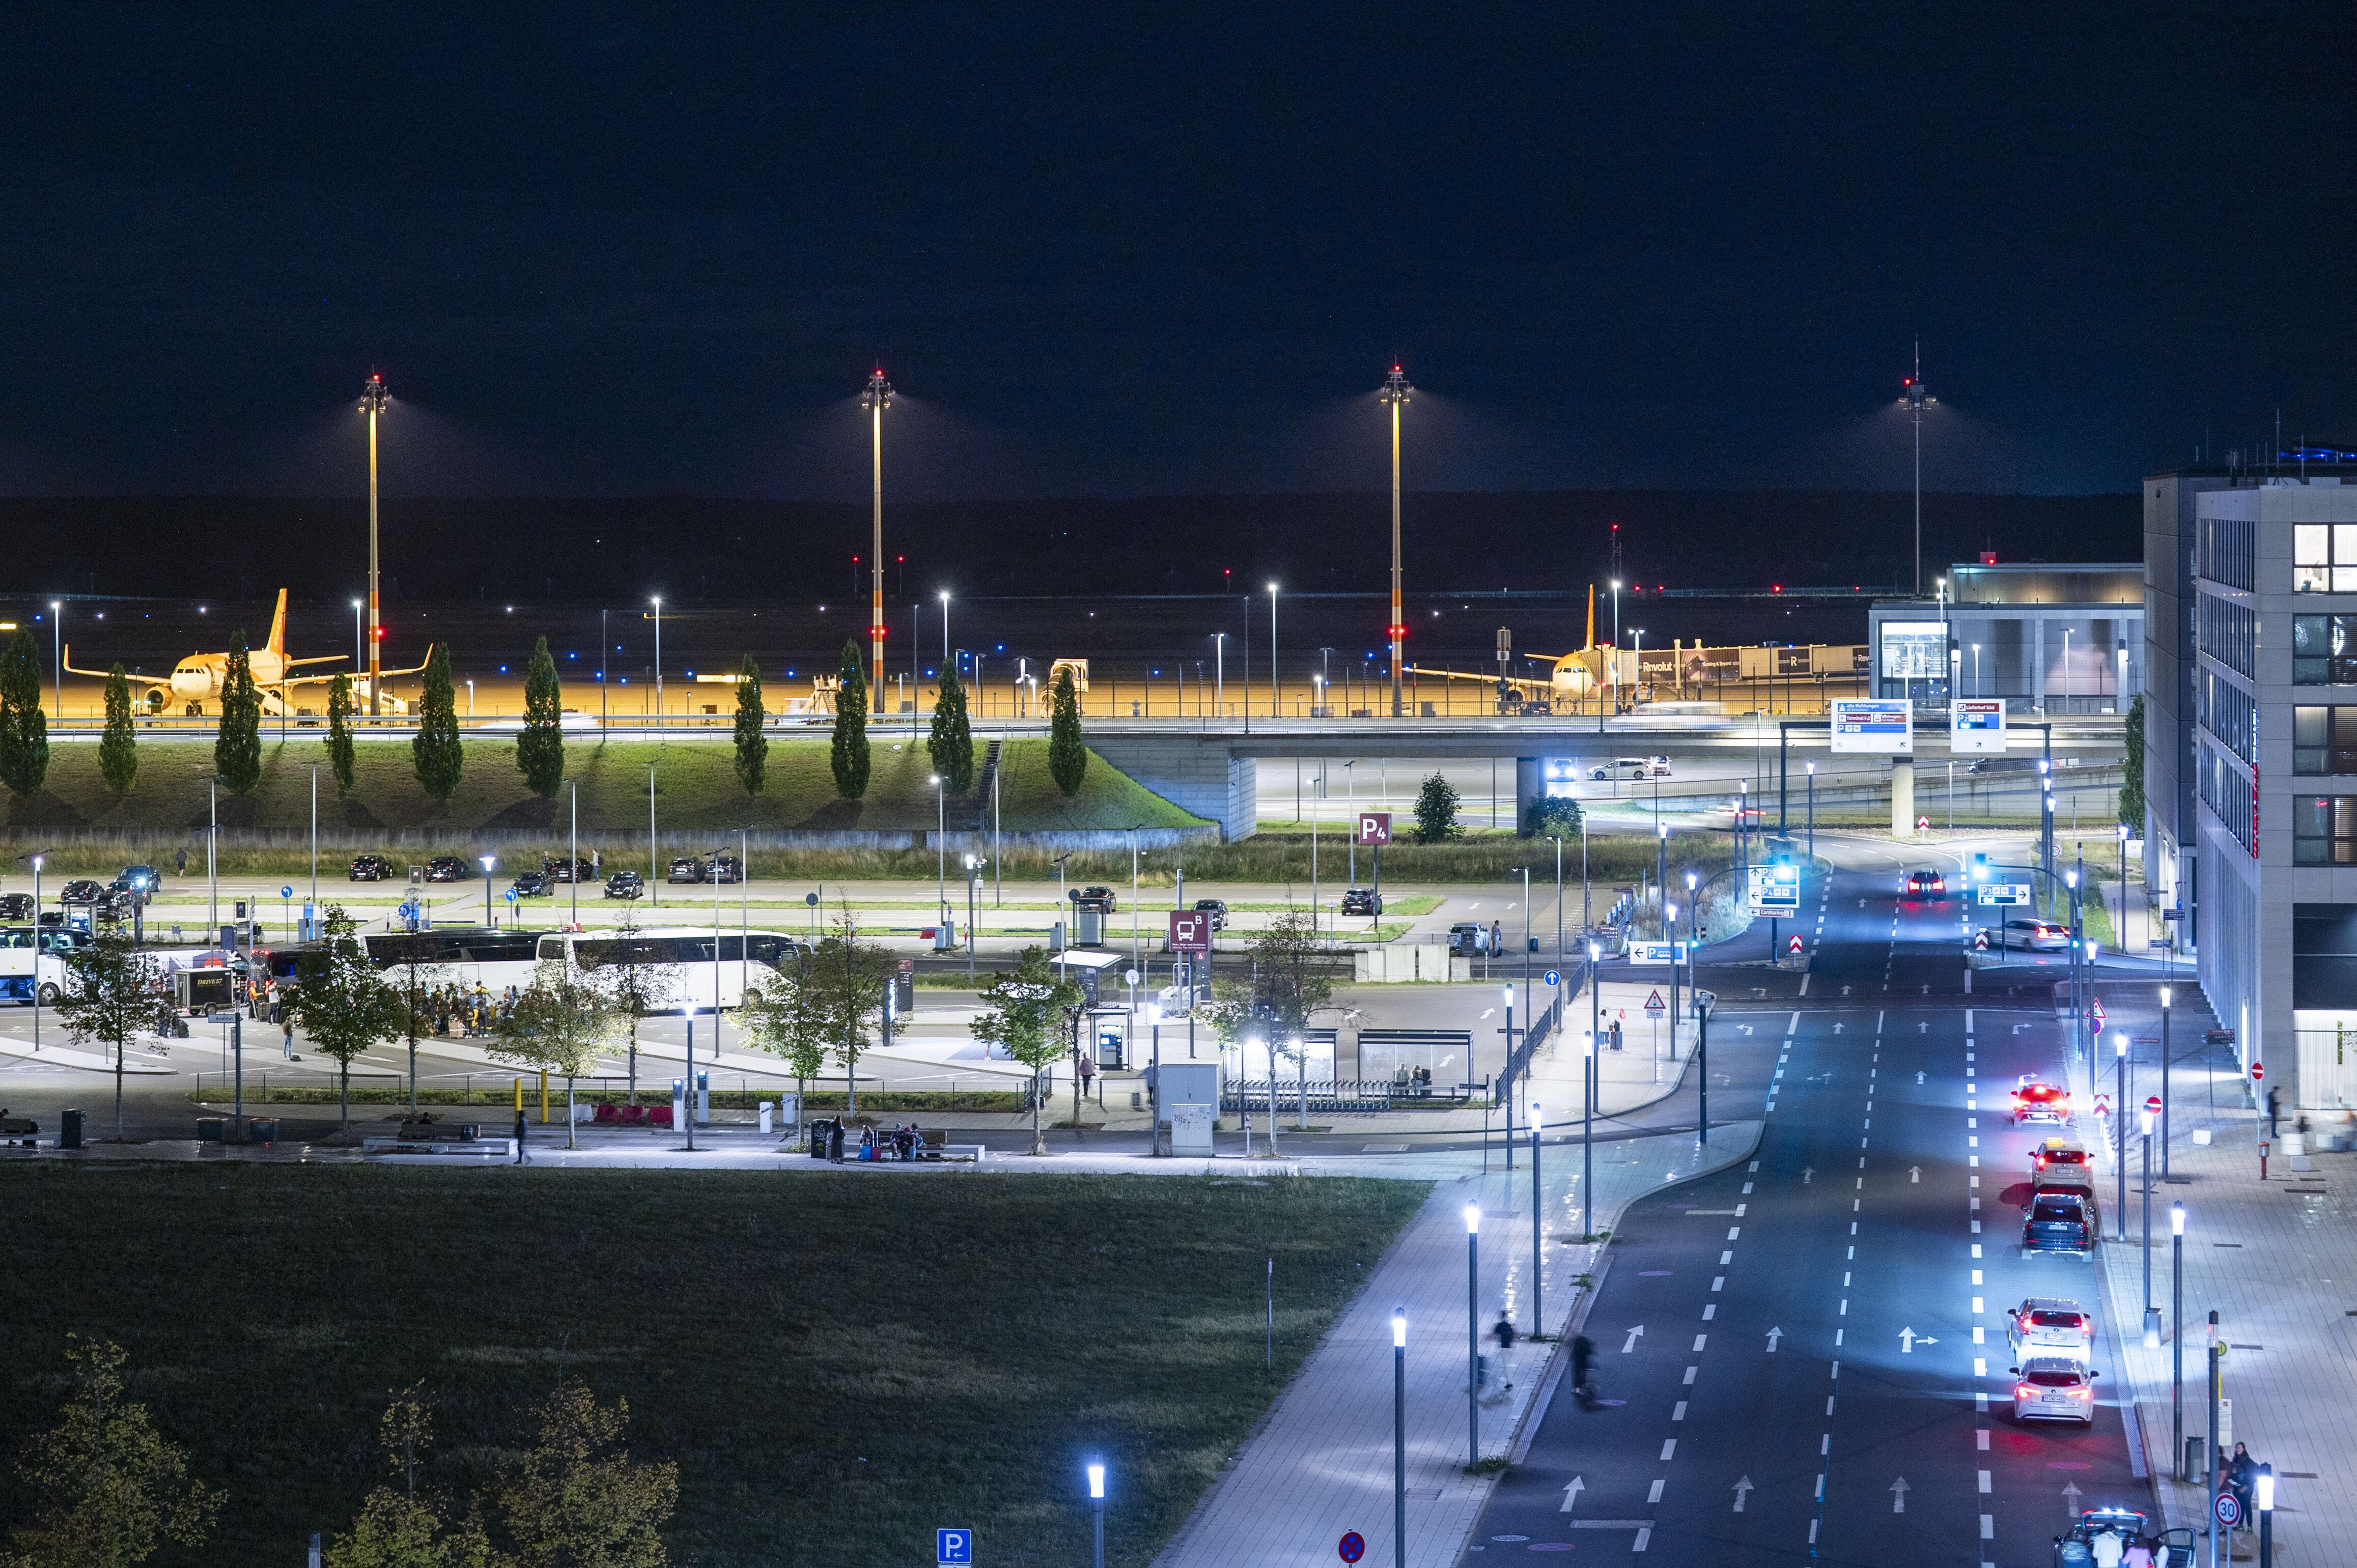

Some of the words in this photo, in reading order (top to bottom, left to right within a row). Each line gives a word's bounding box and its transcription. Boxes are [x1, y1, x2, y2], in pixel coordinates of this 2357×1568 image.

[1790, 656, 1797, 666] R
[1643, 662, 1673, 672] Revolut
[1363, 818, 1386, 839] P4
[1195, 916, 1202, 925] B
[1648, 948, 1656, 958] P
[2220, 1502, 2234, 1517] 30
[946, 1533, 963, 1558] P
